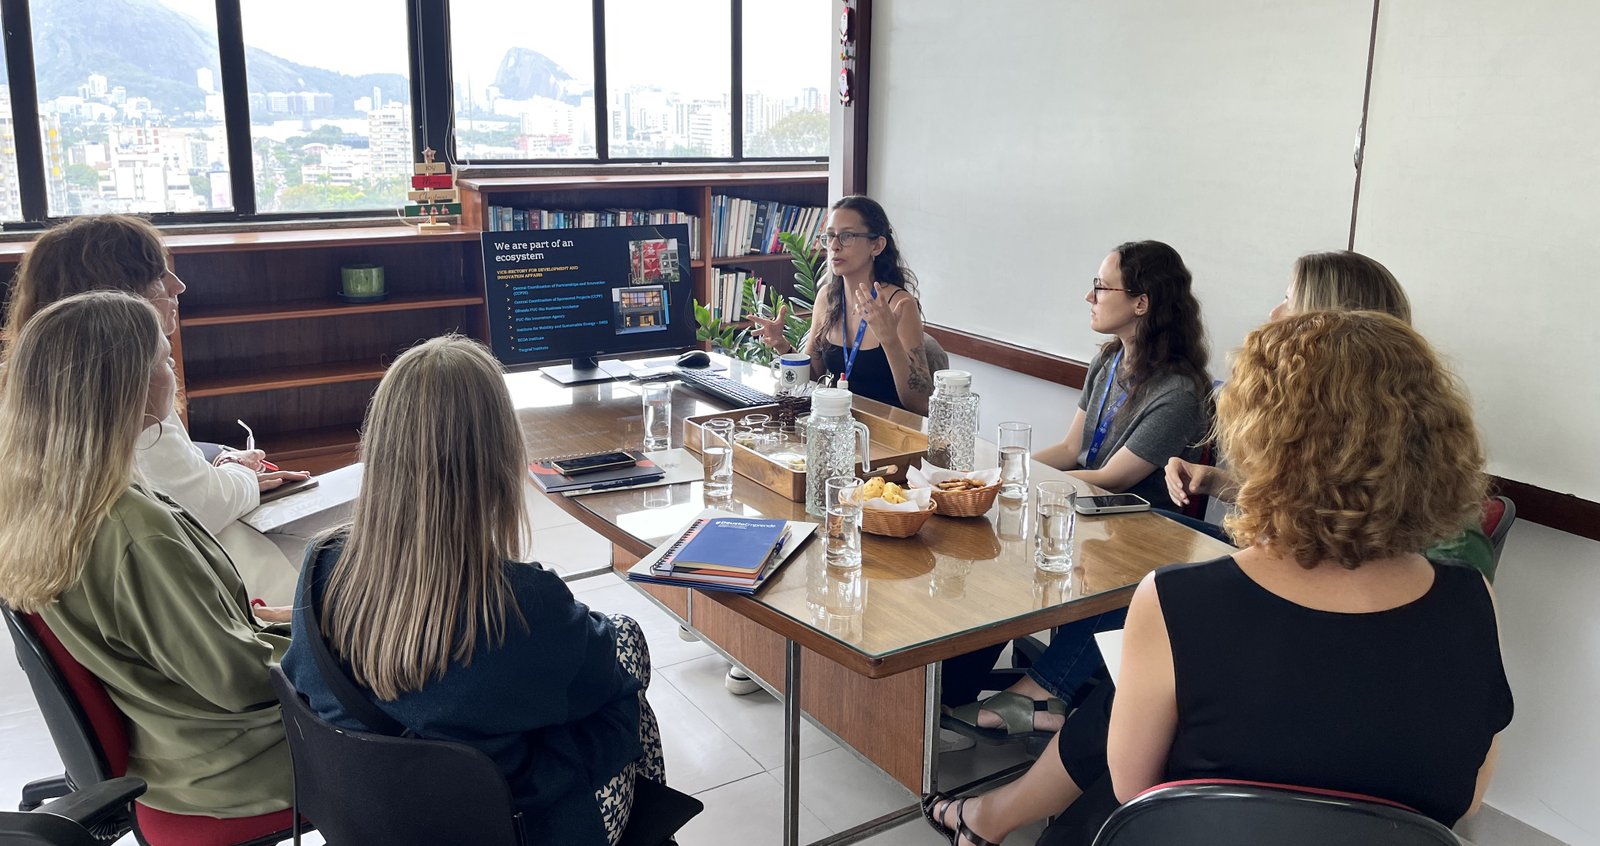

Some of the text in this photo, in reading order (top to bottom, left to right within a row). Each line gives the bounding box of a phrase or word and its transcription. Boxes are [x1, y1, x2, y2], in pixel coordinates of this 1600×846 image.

[494, 242, 510, 250] We
[530, 241, 549, 251] part
[551, 239, 561, 248] of
[495, 252, 544, 262] ecosystem
